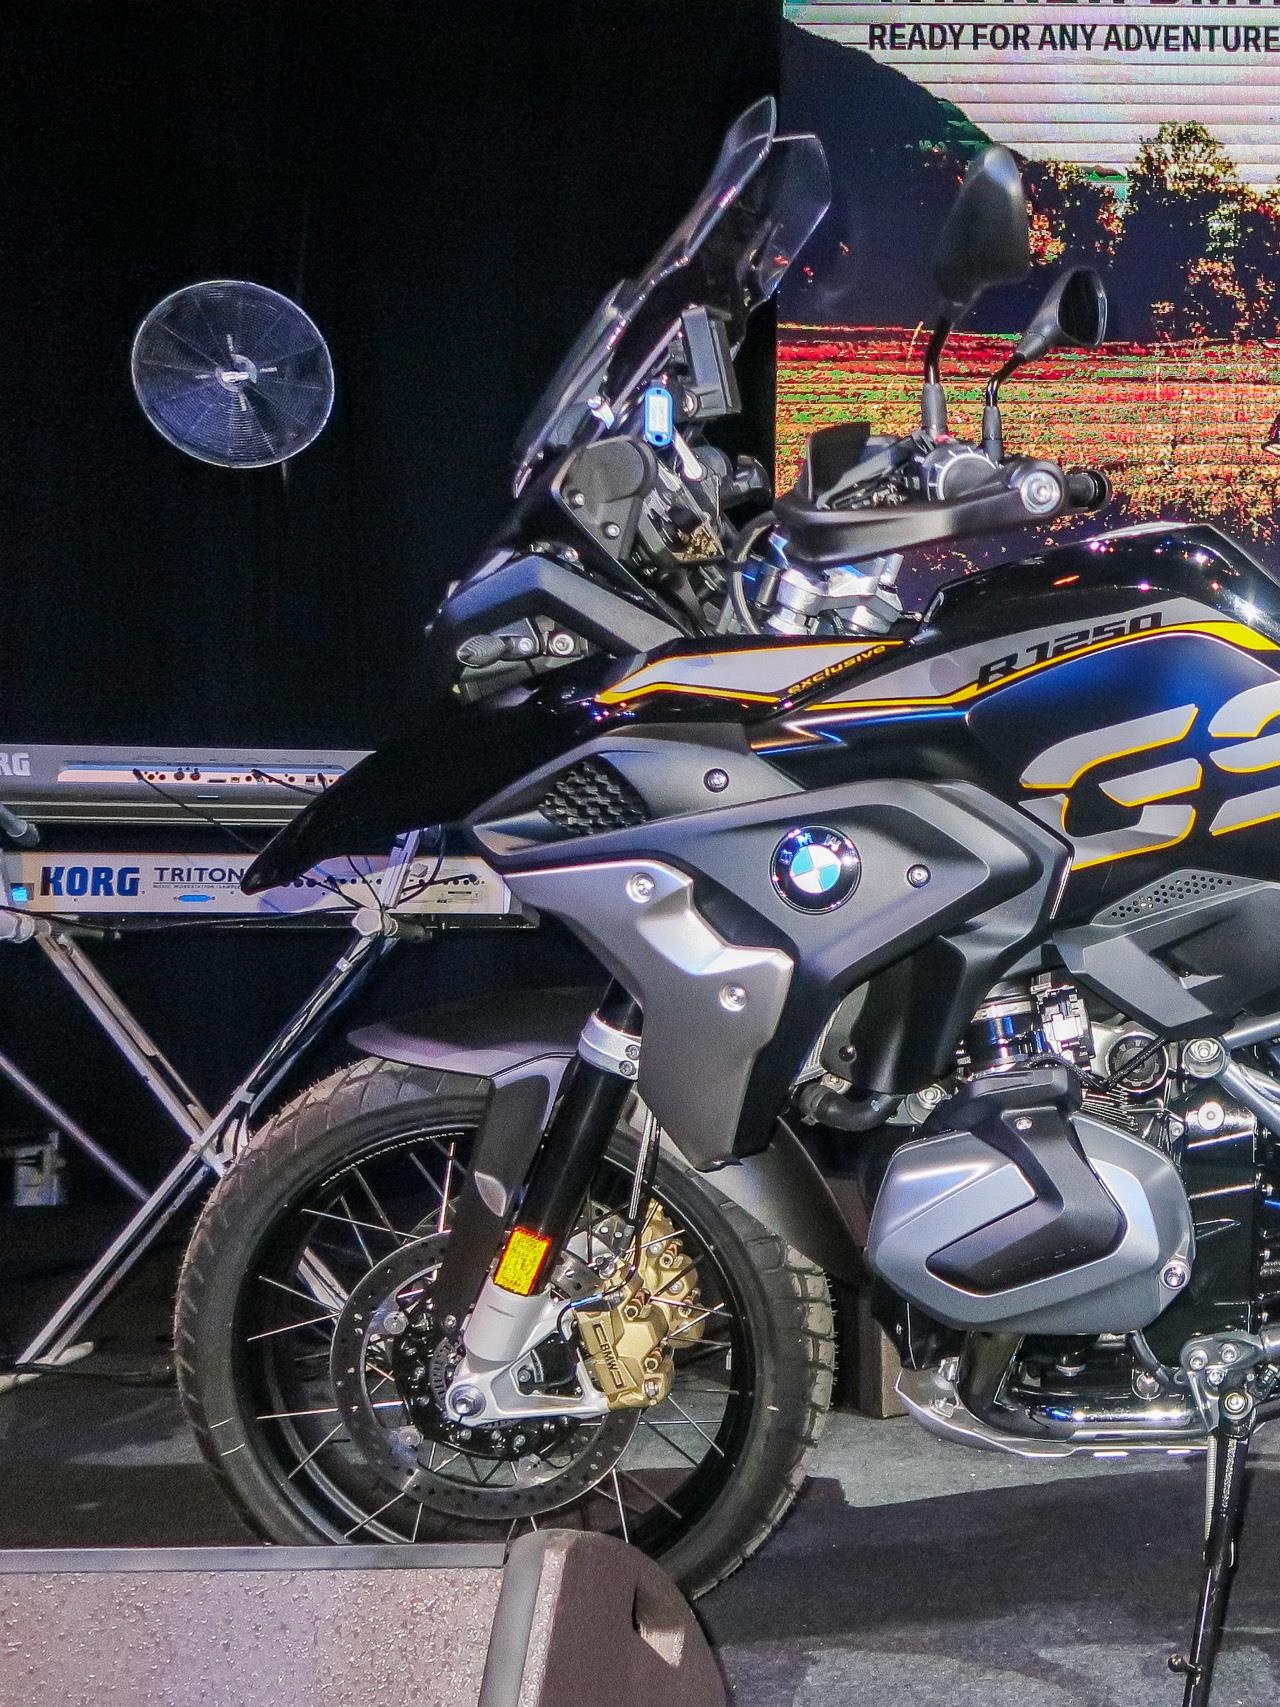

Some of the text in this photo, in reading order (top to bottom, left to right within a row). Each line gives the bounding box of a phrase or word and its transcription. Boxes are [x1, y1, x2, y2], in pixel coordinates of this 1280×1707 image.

[868, 24, 965, 51] READY
[972, 24, 1030, 51] FOR
[1038, 24, 1097, 51] ANY
[1104, 24, 1280, 52] ADVENTURE
[976, 611, 1163, 691] R 1250
[787, 645, 886, 694] exclusive
[40, 866, 141, 897] KORG
[153, 867, 245, 883] TRITON
[600, 1343, 621, 1370] BMW
